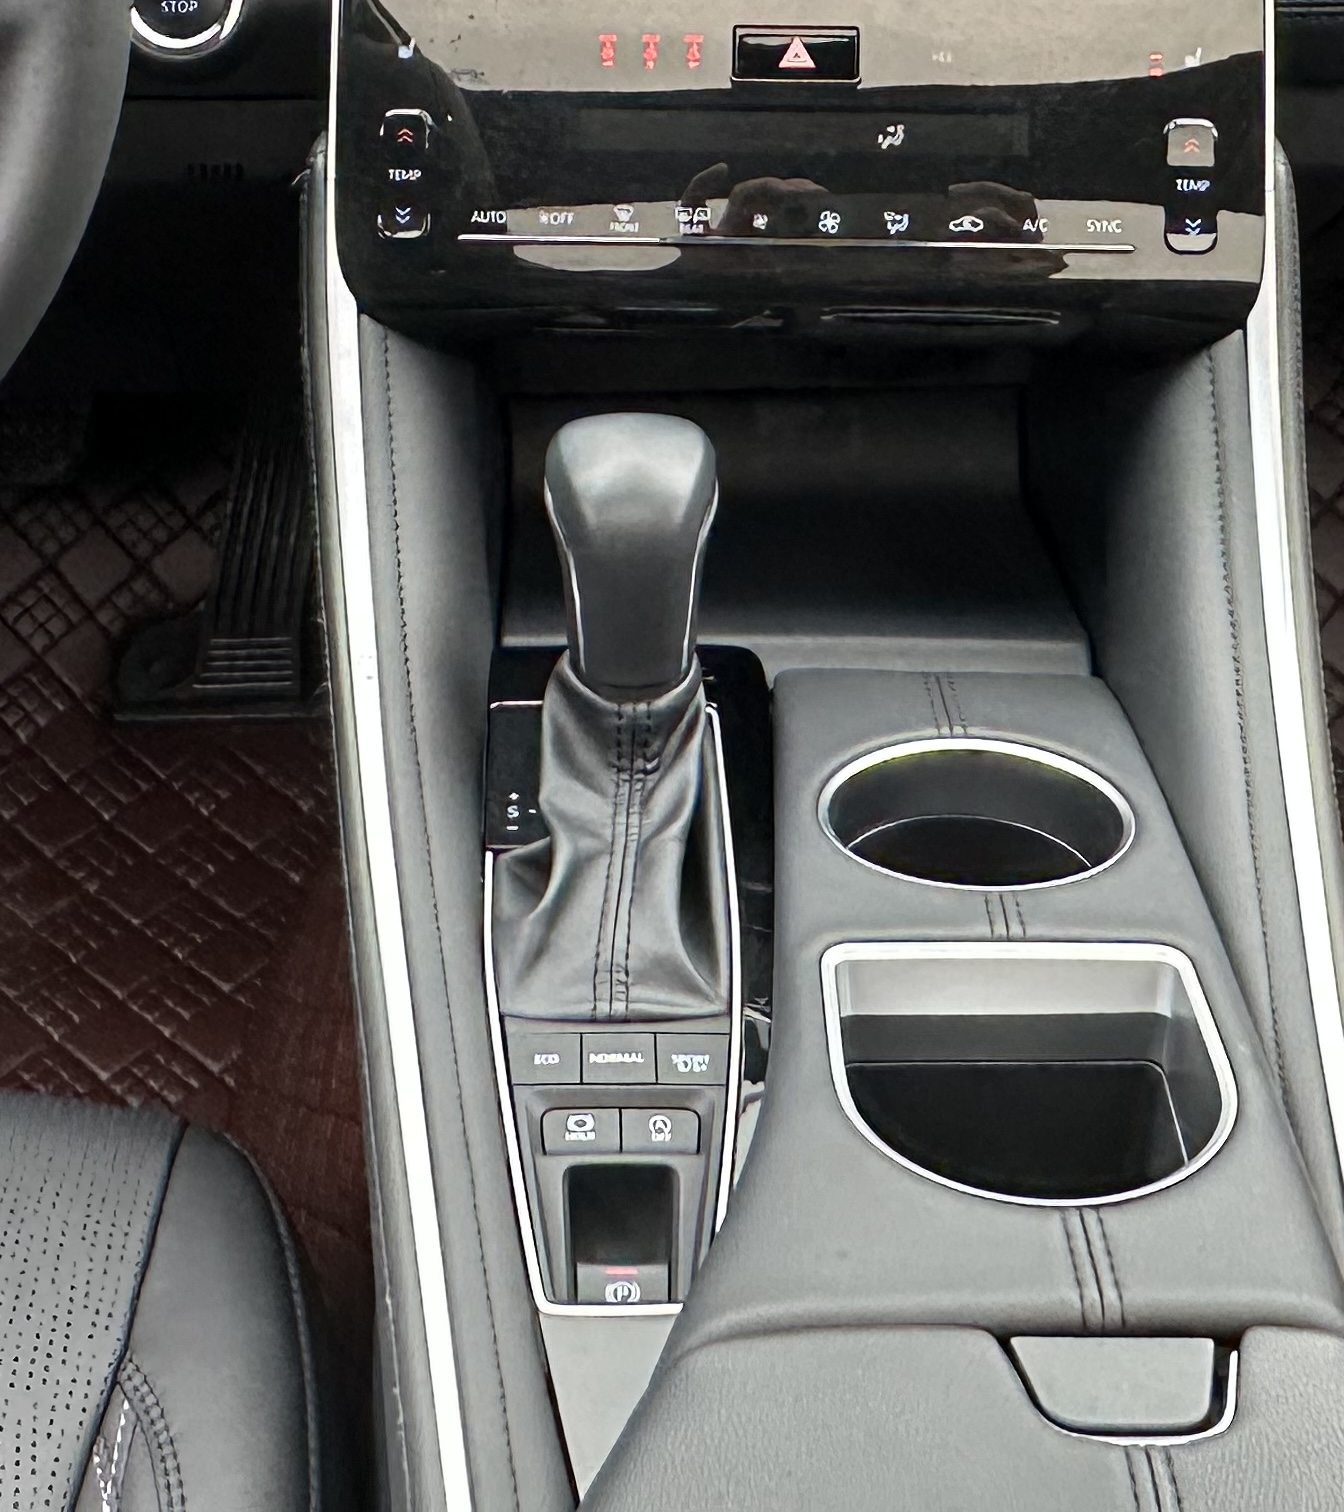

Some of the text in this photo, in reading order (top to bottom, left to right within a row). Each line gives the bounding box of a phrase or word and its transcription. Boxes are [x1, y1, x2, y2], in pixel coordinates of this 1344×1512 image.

[161, 0, 198, 13] STOP
[388, 169, 422, 181] TEMP
[1176, 178, 1211, 191] TEMP
[471, 210, 506, 224] AUTO
[550, 212, 575, 225] OFF
[1023, 218, 1049, 233] A/C
[1086, 219, 1122, 234] SYNC
[507, 805, 519, 818] S
[534, 1053, 560, 1065] ECO
[589, 1052, 644, 1064] NORMAL
